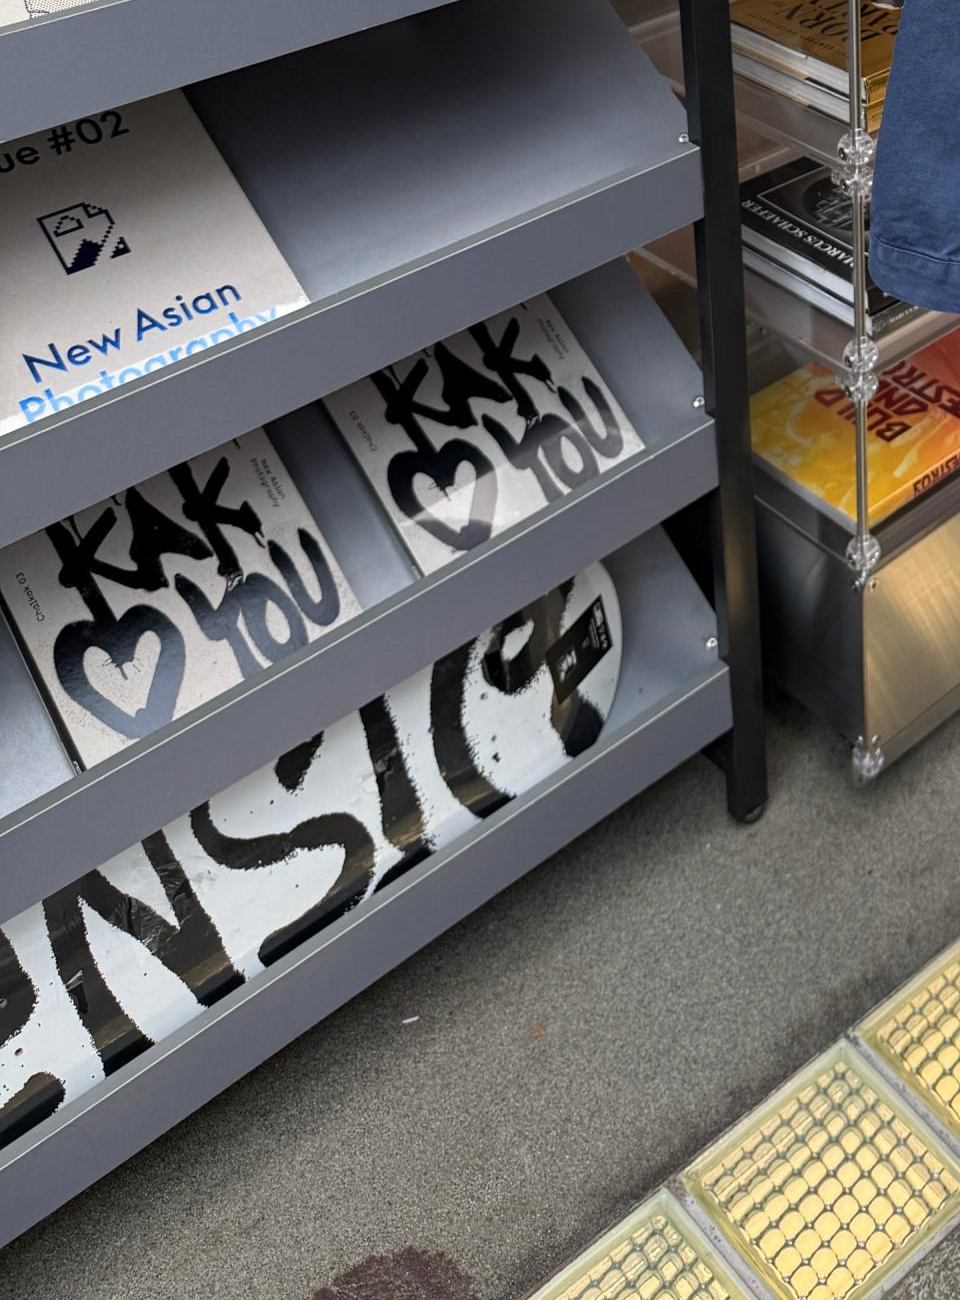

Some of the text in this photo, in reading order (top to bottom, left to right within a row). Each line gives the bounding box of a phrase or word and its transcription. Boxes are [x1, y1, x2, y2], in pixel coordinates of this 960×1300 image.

[48, 109, 131, 156] #02
[741, 199, 809, 238] SCHAEFER
[22, 283, 243, 384] New Asian
[481, 375, 624, 504] YOU
[174, 527, 341, 679] YOU
